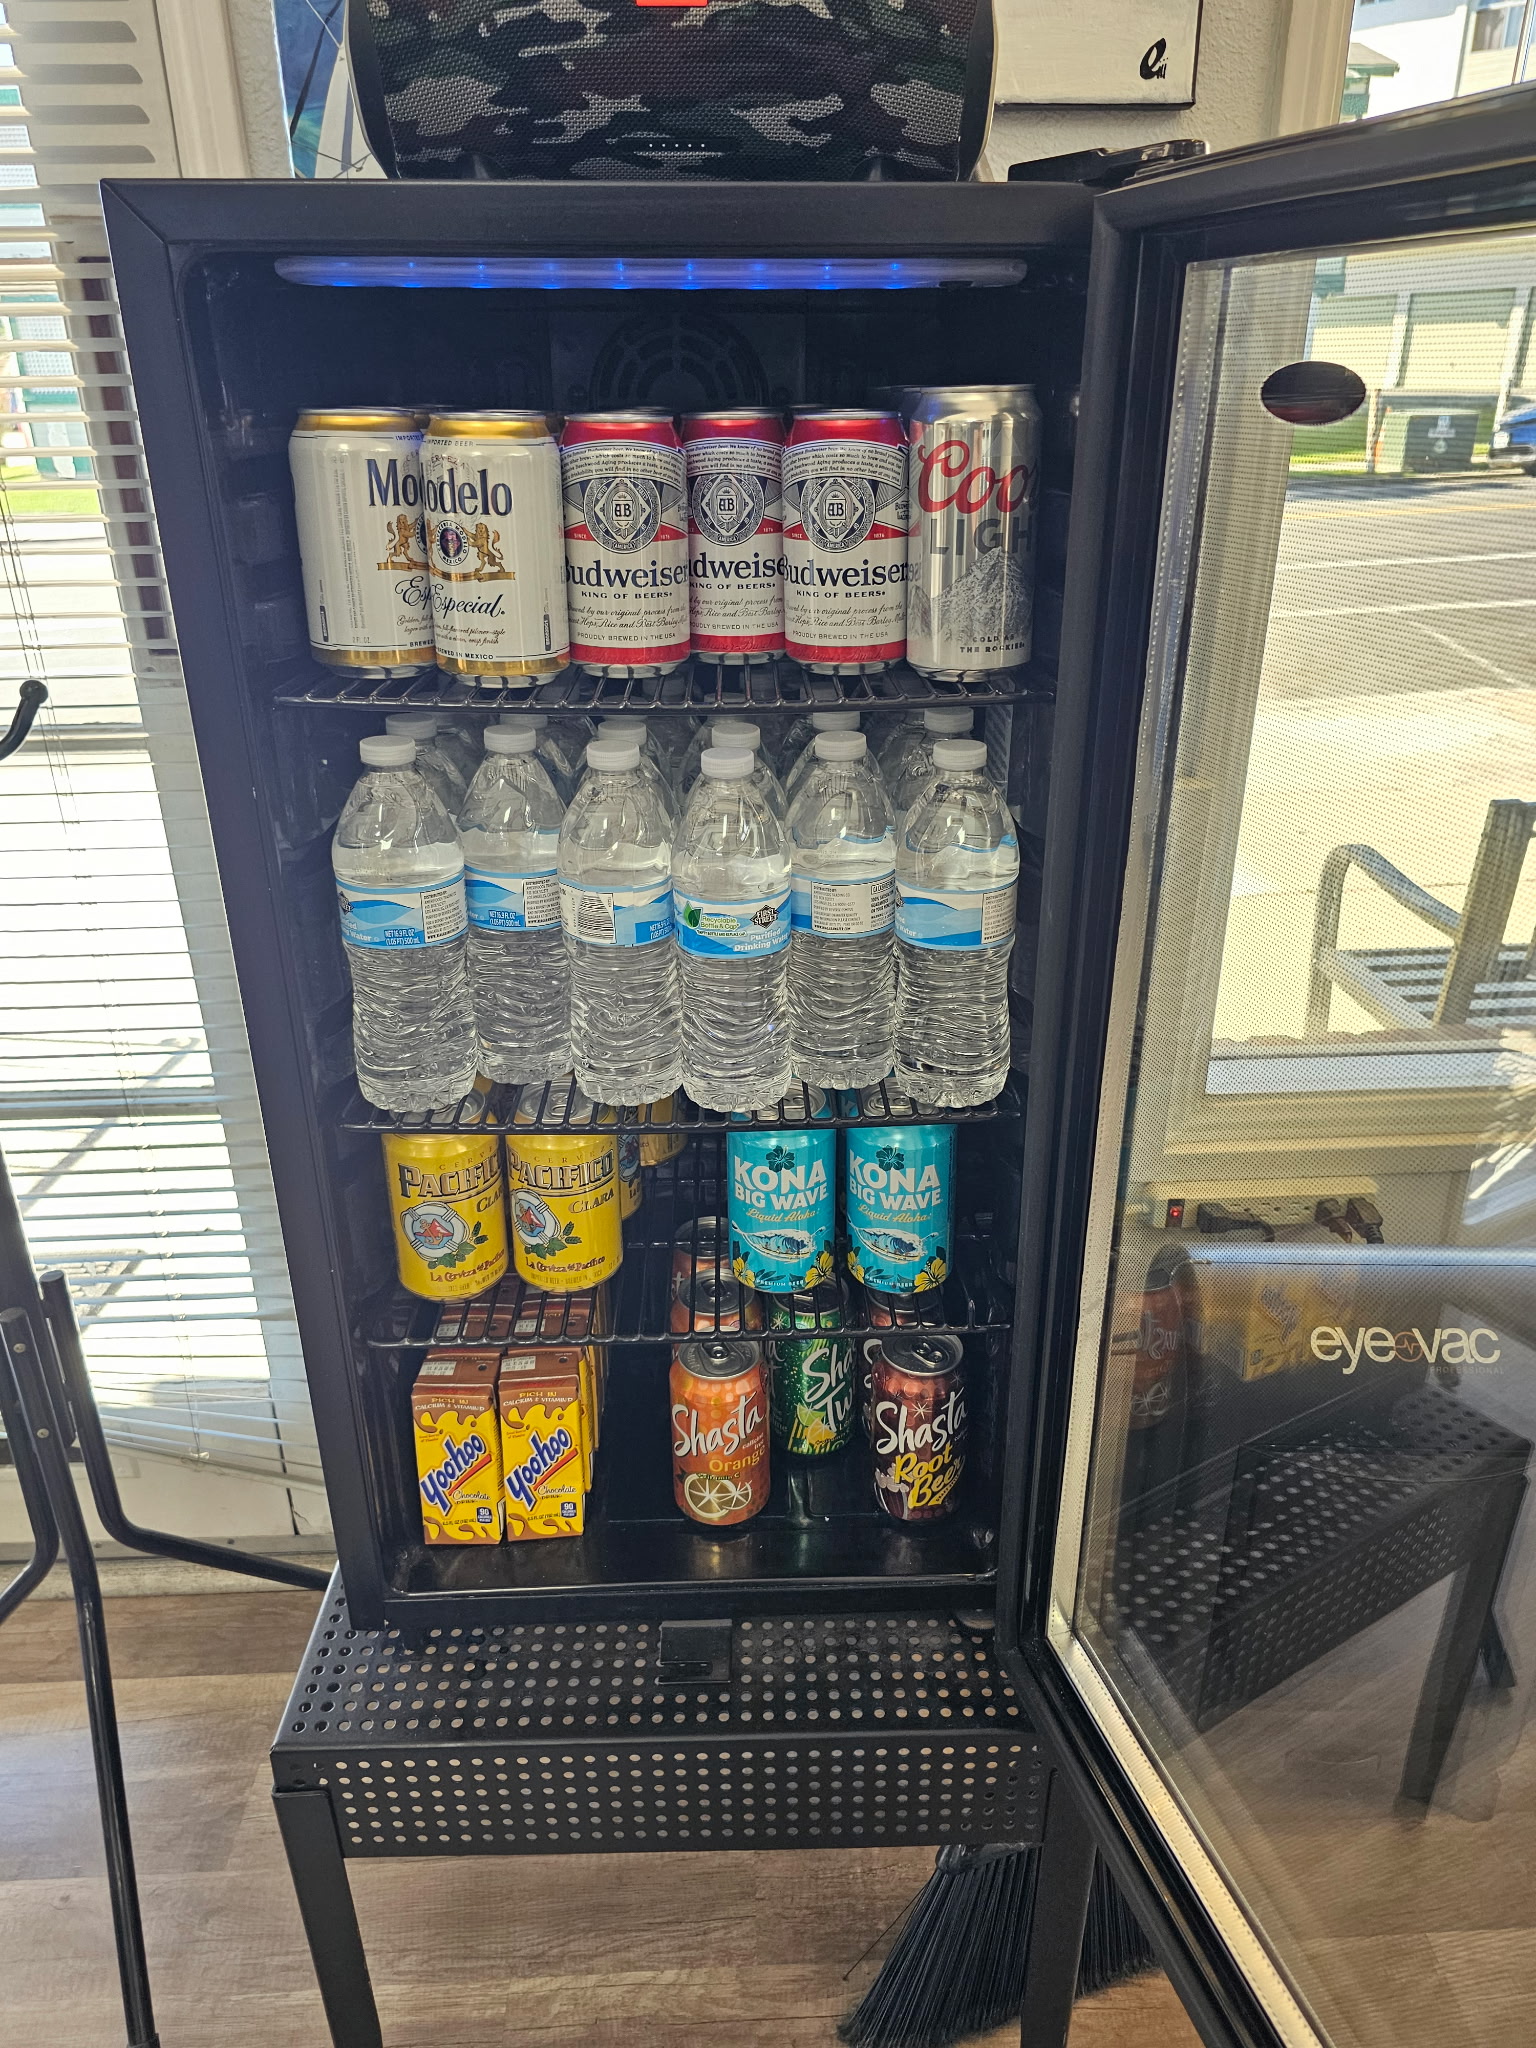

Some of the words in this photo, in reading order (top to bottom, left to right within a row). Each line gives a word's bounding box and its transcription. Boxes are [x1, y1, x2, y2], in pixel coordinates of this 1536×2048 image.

[420, 467, 513, 516] odelo
[689, 552, 784, 579] dweise
[581, 591, 608, 599] KING
[690, 582, 712, 590] KING
[796, 590, 819, 598] KING
[464, 652, 494, 660] MEXICO
[732, 941, 771, 952] Drinking
[750, 927, 781, 941] Purified
[507, 1143, 614, 1190] PACIFICO
[734, 1155, 827, 1194] KONA
[850, 1149, 941, 1194] KONA
[568, 1188, 614, 1214] CLARA
[734, 1181, 766, 1209] BIG
[770, 1182, 828, 1210] WAVE
[850, 1178, 876, 1206] BIG
[879, 1190, 942, 1211] WAVE
[526, 1256, 536, 1269] La
[430, 1271, 443, 1282] La
[672, 1389, 765, 1457] Shasta
[876, 1387, 968, 1455] Shasta
[709, 1445, 765, 1472] Orange
[893, 1440, 953, 1484] Root
[452, 1490, 491, 1501] Chocolate
[537, 1484, 577, 1495] Chocolate
[907, 1457, 963, 1511] Beer
[479, 1508, 490, 1516] 90
[563, 1502, 574, 1510] 90
